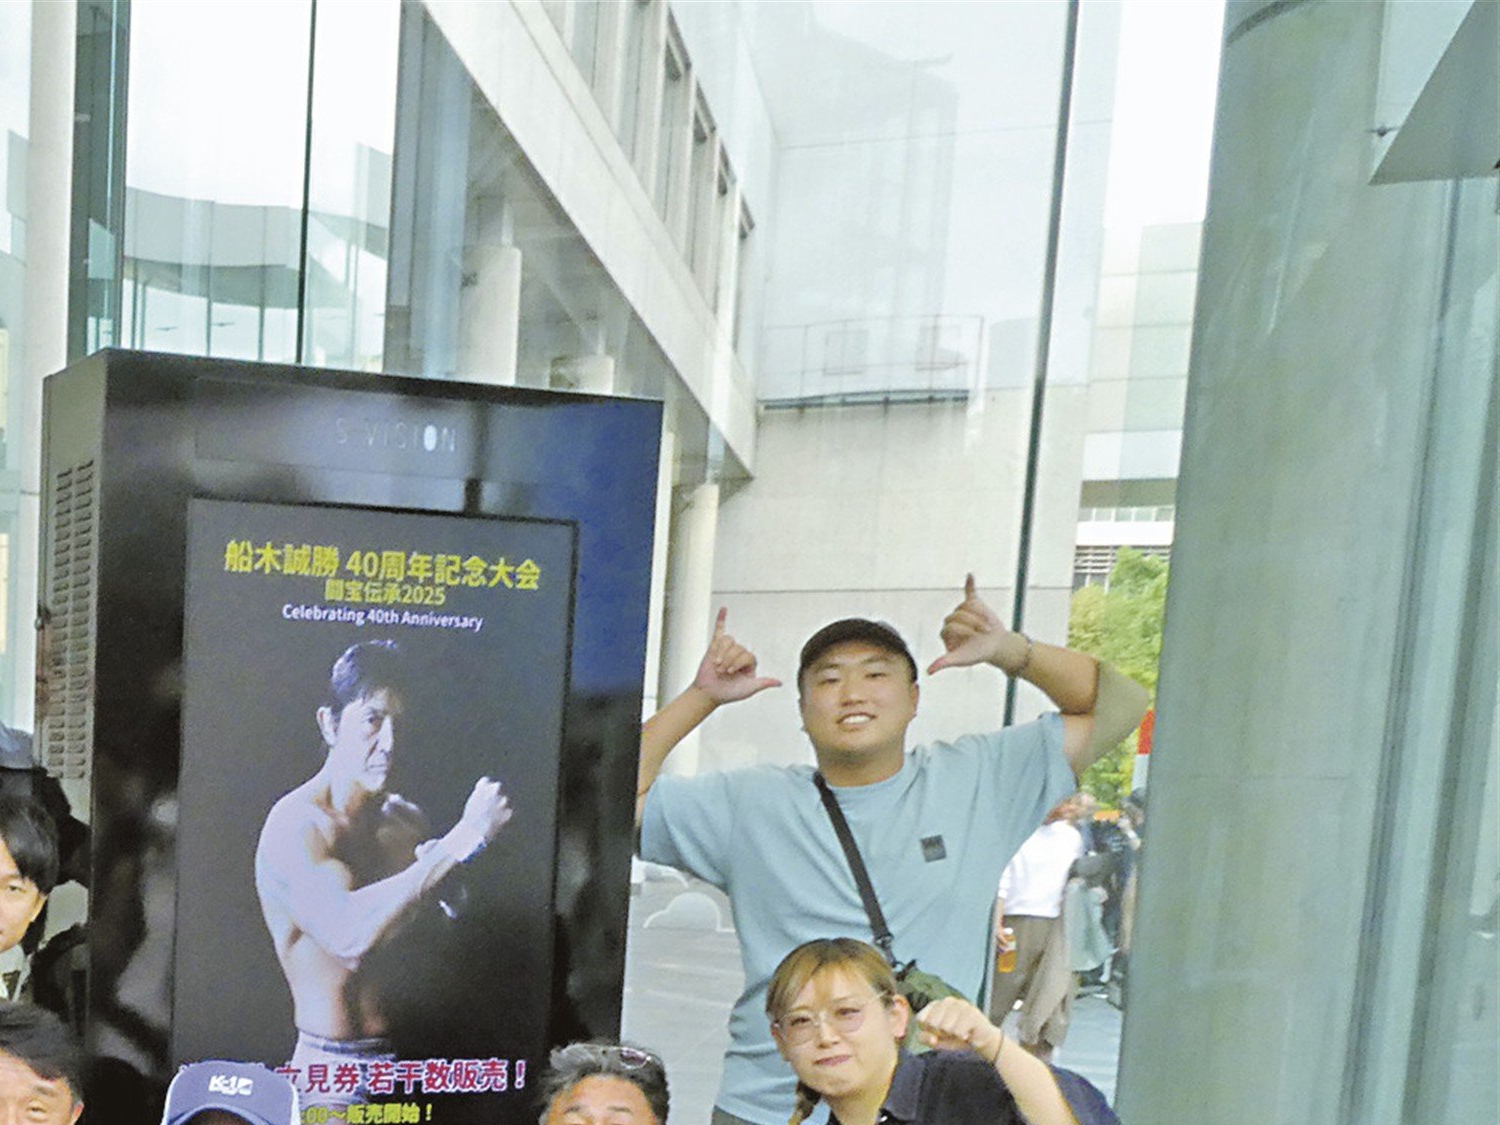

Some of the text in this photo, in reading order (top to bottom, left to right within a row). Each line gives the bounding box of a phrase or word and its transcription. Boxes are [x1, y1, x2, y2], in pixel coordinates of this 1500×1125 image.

[225, 540, 542, 590] 船木誠勝 40周年記念大会
[282, 603, 484, 633] Celebrating 40th Anniversary
